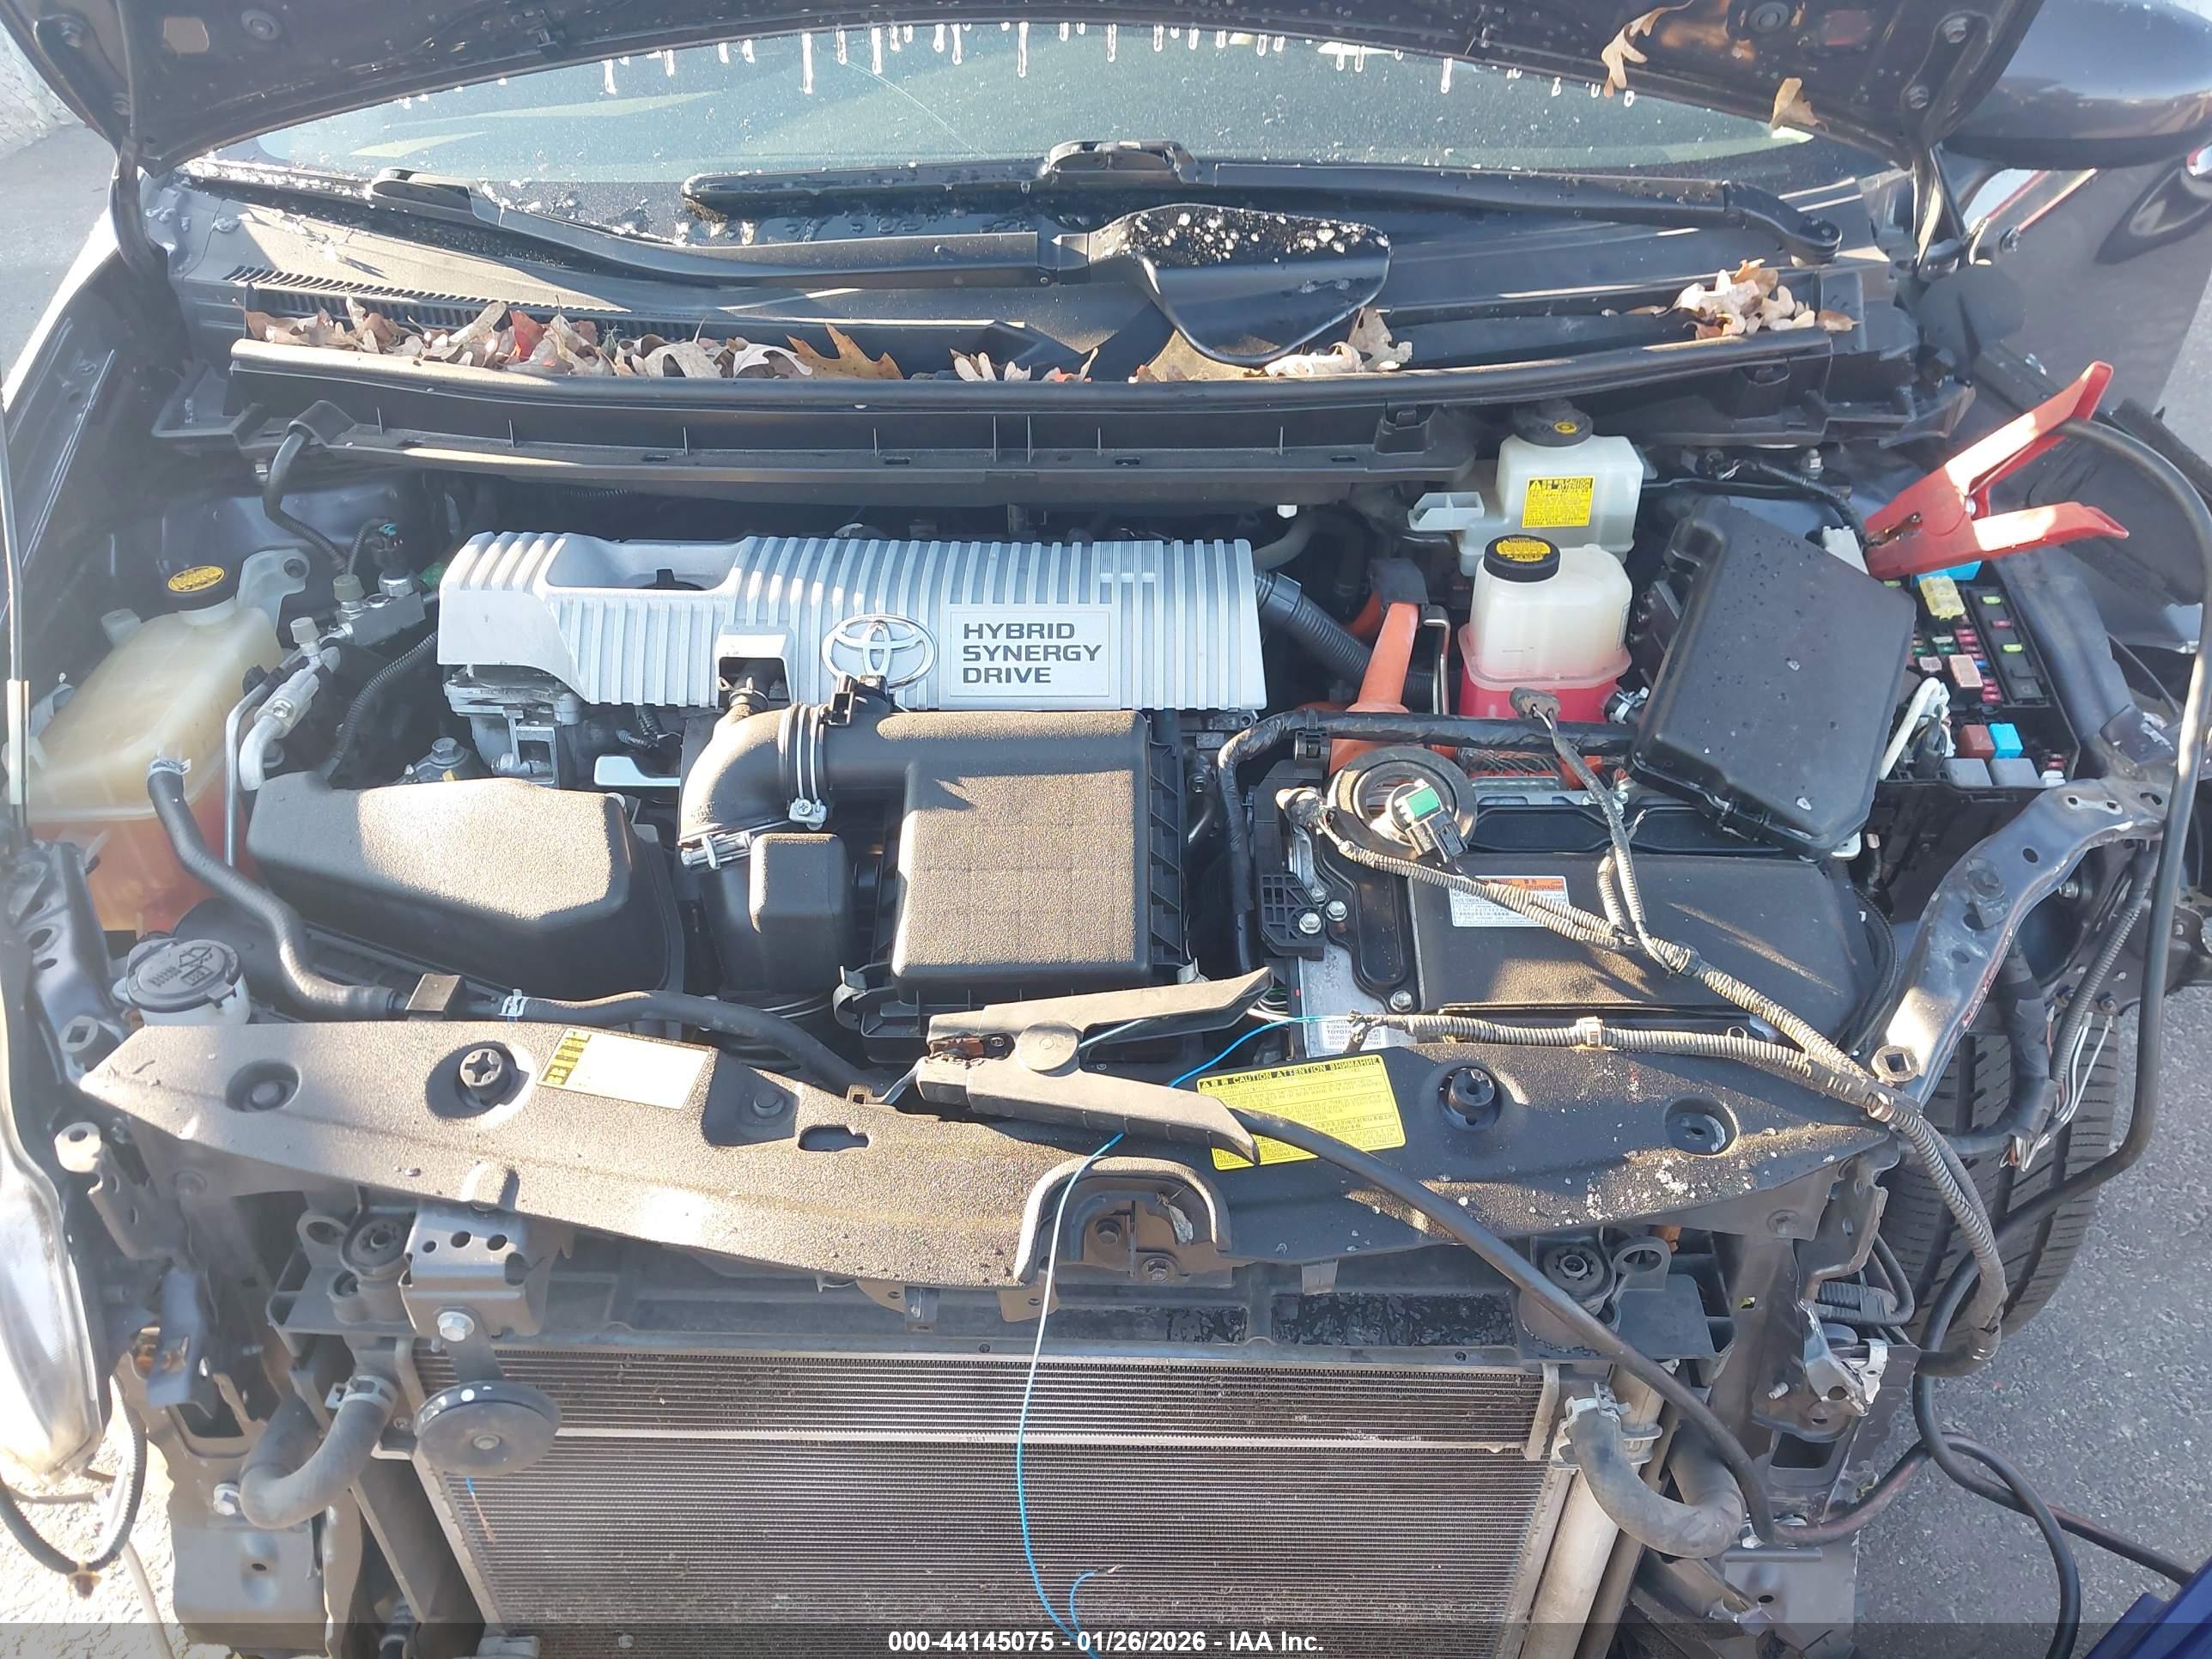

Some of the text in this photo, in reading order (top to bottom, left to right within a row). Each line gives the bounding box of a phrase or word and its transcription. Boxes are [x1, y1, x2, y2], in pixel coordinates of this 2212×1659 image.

[963, 623, 1075, 640] HYBRID
[963, 644, 1103, 662] SYNERGY
[963, 667, 1051, 684] DRIVE
[1233, 1072, 1272, 1085] CAUTION
[1277, 1064, 1327, 1079] ATTENTION
